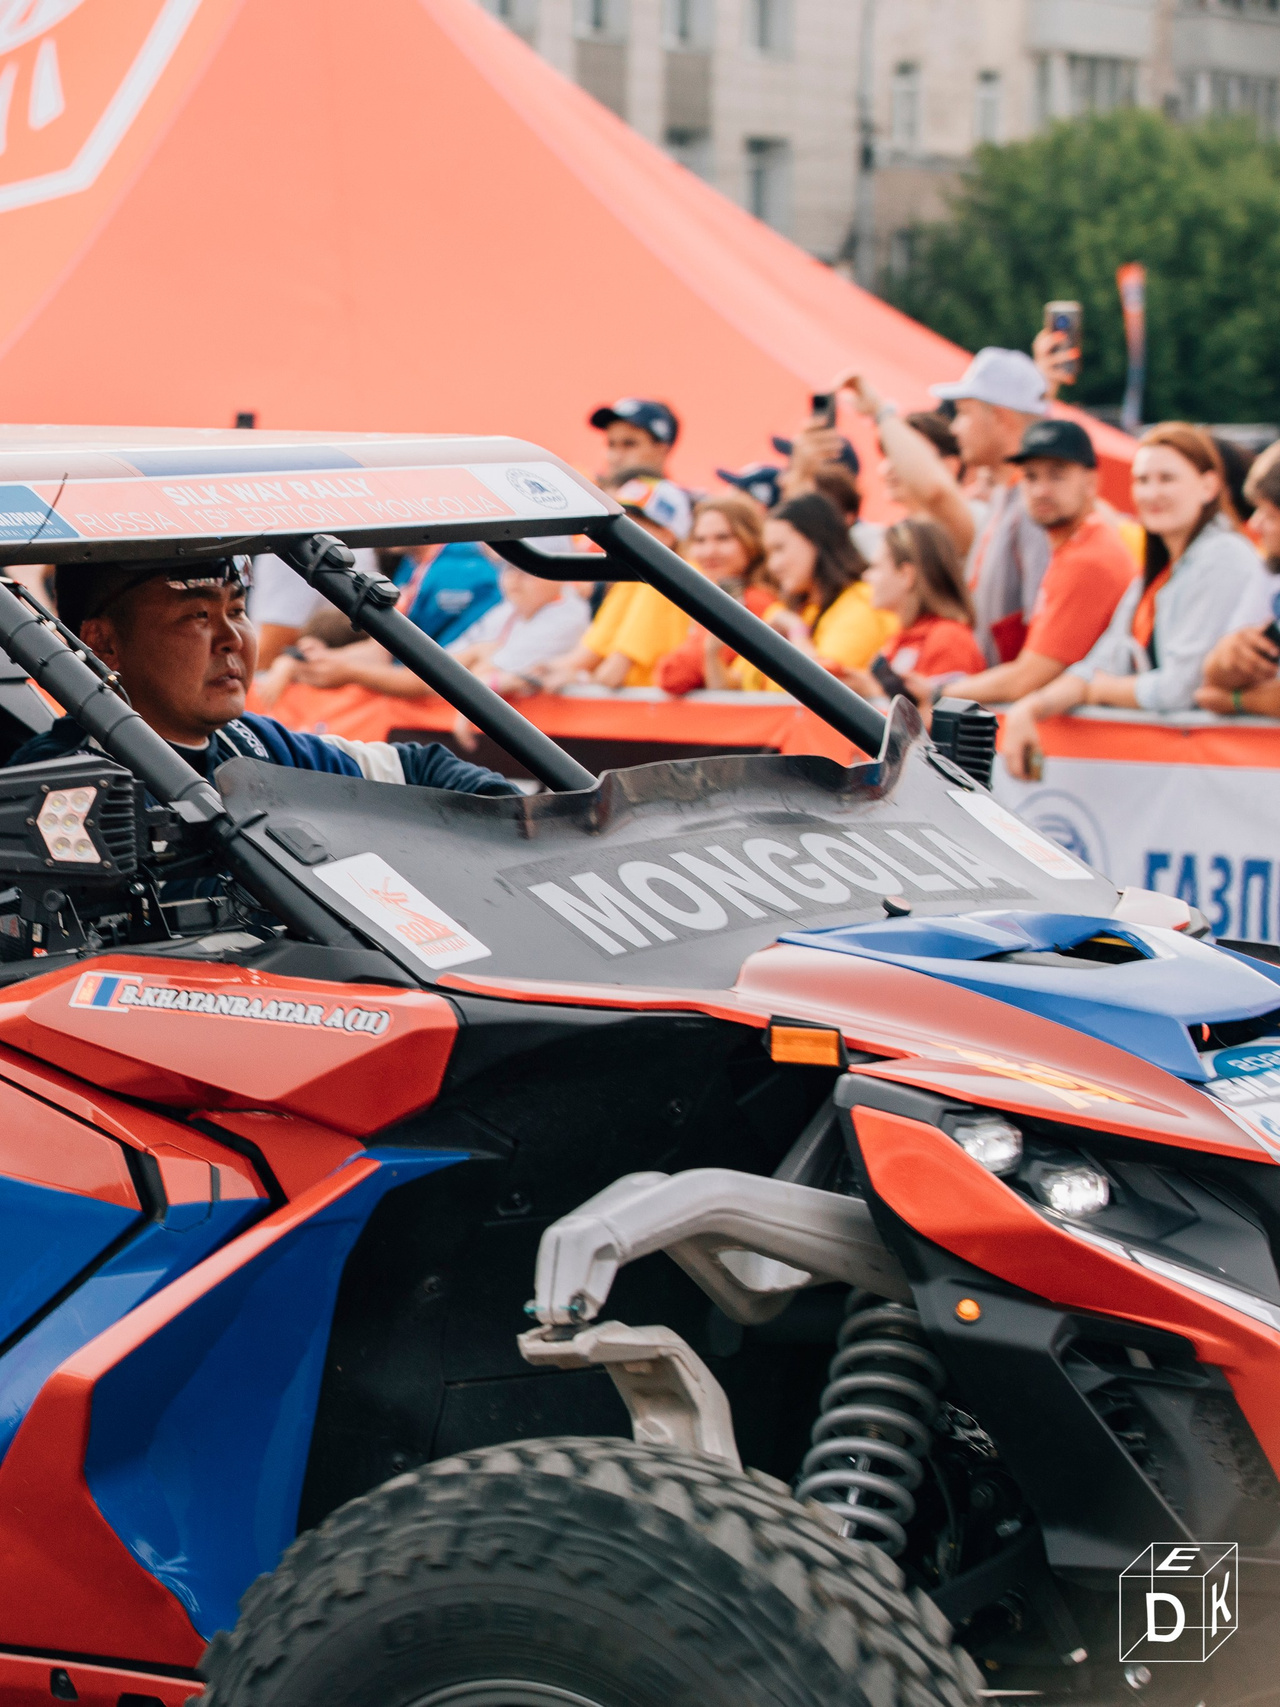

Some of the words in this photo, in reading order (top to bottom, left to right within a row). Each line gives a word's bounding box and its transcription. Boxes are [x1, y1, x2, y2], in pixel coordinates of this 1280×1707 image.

[162, 484, 232, 506] SILK
[223, 481, 291, 504] WAY
[288, 476, 375, 500] RALLY
[75, 510, 184, 534] RUSSIA
[194, 508, 236, 529] 15th
[236, 503, 347, 528] EDITION
[368, 495, 505, 520] MONGOLIA
[527, 827, 1028, 956] MONGOLIA
[1226, 1050, 1280, 1072] 202
[1204, 1070, 1280, 1104] SIL
